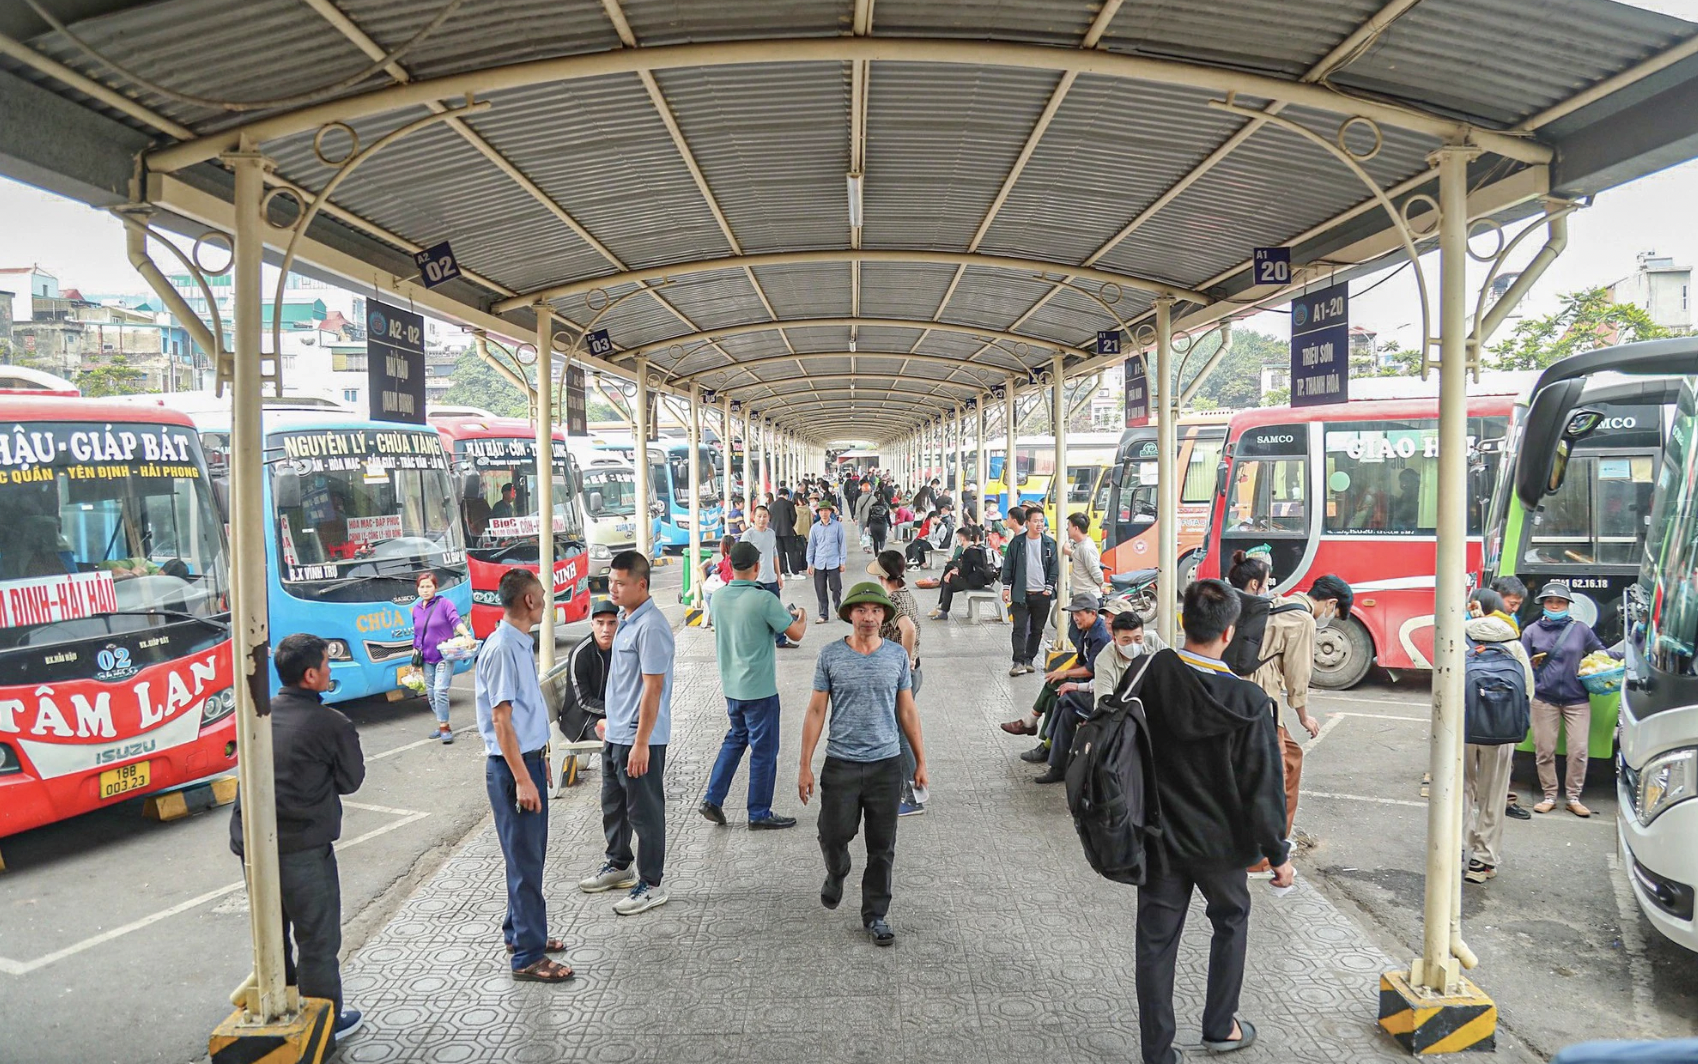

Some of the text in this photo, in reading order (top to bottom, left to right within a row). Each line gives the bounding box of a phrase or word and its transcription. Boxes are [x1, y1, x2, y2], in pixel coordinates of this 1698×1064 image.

[417, 252, 430, 264] A2
[1256, 250, 1268, 259] A1
[425, 255, 456, 282] 02
[1260, 261, 1288, 281] 20
[1313, 296, 1344, 322] A1-20
[389, 318, 420, 345] A2-02
[592, 338, 610, 353] 03
[1103, 339, 1118, 352] 21
[1302, 341, 1334, 369] TRIỆU SƠN
[1305, 375, 1326, 396] THANH
[1326, 368, 1339, 394] HÓA
[1598, 416, 1636, 430] MCO
[70, 424, 137, 461] GIÁP
[141, 426, 189, 462] BÁT
[283, 431, 349, 457] NGUYÊN
[350, 430, 366, 454] LÝ
[376, 430, 411, 454] CHÙA
[411, 432, 441, 456] VÀNG
[1256, 434, 1294, 444] SAMCO
[67, 465, 95, 480] YÊN
[98, 465, 130, 481] ĐỊNH
[140, 463, 161, 478] HẢI
[163, 466, 199, 478] PHONG
[290, 567, 304, 581] B.X
[323, 565, 338, 579] TRỤ
[1572, 578, 1608, 589] 62.16.18
[356, 607, 404, 633] CHÙA
[97, 647, 132, 671] 02
[0, 655, 216, 738] TÂM LAN
[96, 739, 156, 765] ISUZU
[117, 765, 136, 780] 18B
[106, 775, 145, 795] 003.23
